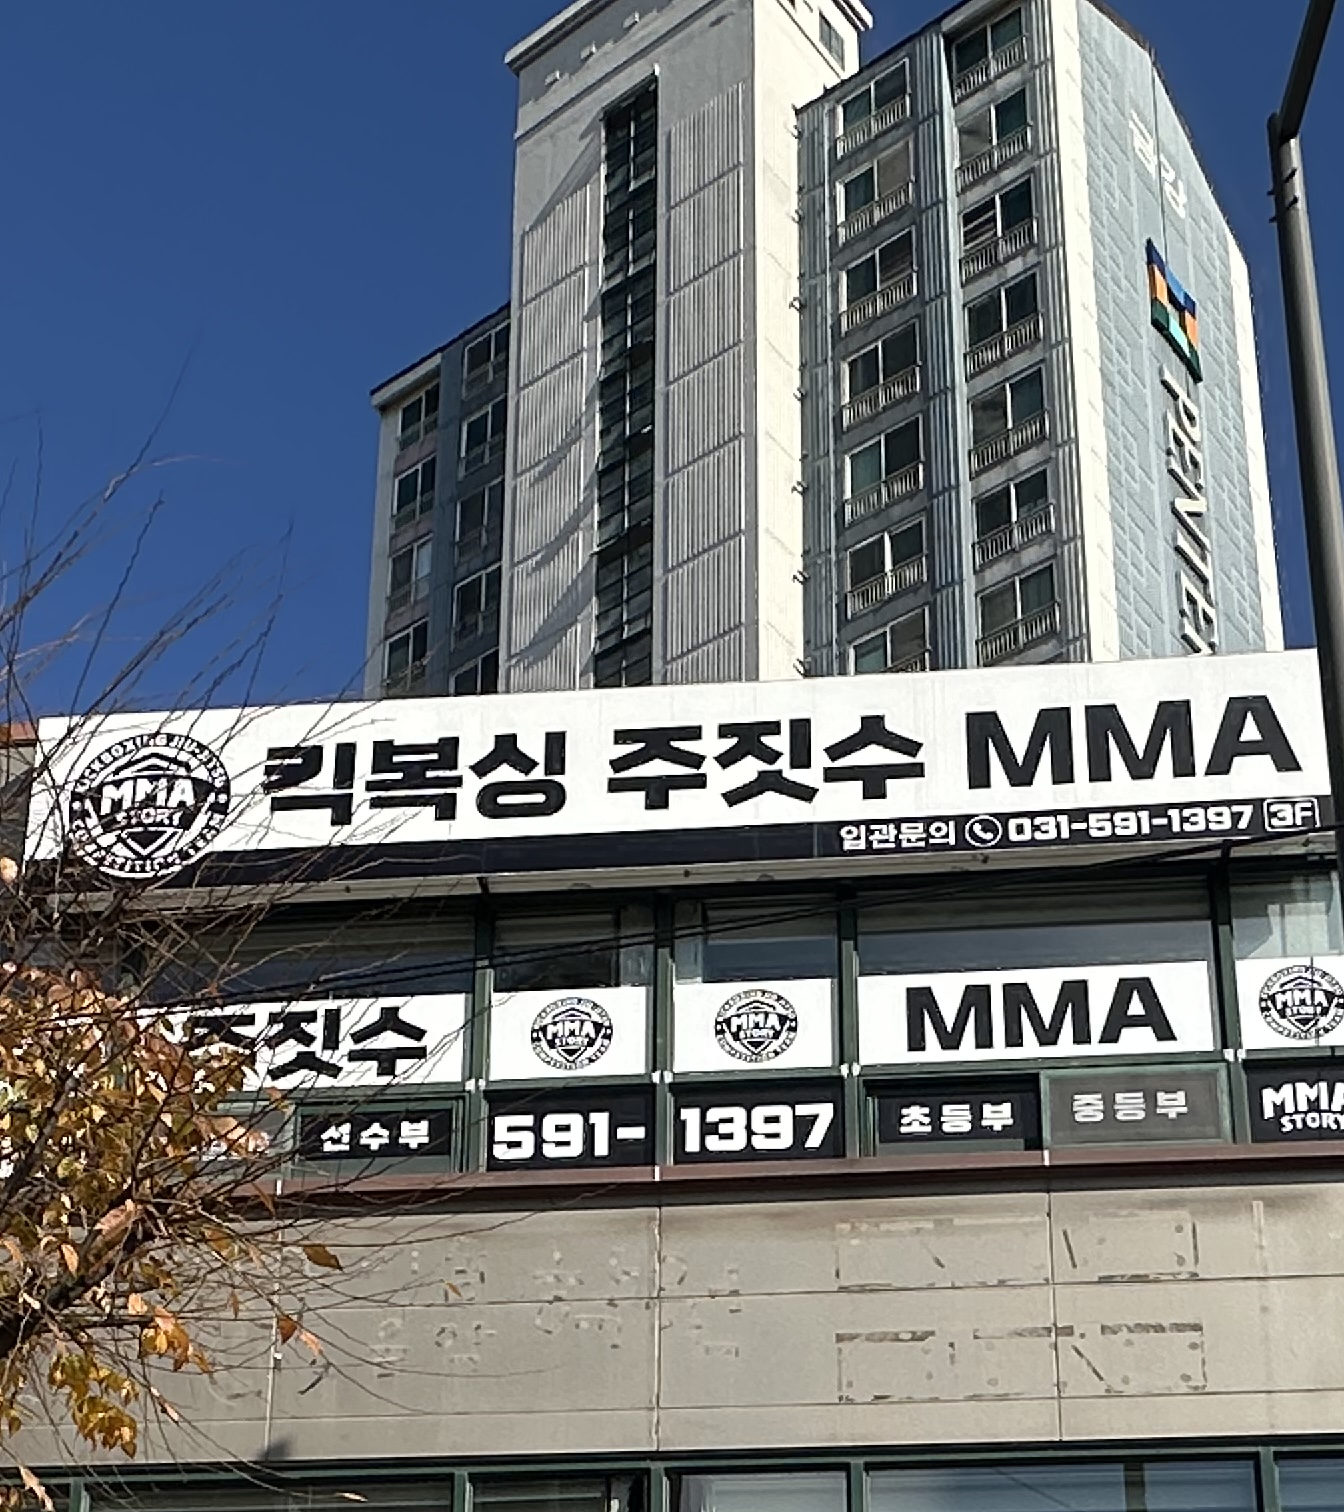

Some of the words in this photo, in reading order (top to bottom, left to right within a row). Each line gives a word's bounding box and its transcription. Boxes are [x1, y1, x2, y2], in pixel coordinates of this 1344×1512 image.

[264, 732, 566, 825] 킥복싱
[607, 715, 925, 809] 주짓수
[965, 695, 1302, 789] MMA
[101, 778, 195, 815] MMA
[840, 819, 955, 851] 입관문의
[1007, 805, 1252, 842] 031-591-1397
[1270, 801, 1313, 828] 3F
[906, 977, 1176, 1053] MMA
[1275, 989, 1328, 1009] MMA
[546, 1020, 596, 1040] MMA
[730, 1013, 781, 1033] MMA
[898, 1101, 1014, 1136] 초등부
[1072, 1090, 1188, 1123] 중등부
[321, 1112, 429, 1153] 선수부
[492, 1111, 646, 1161] 591-
[680, 1103, 834, 1154] 1397
